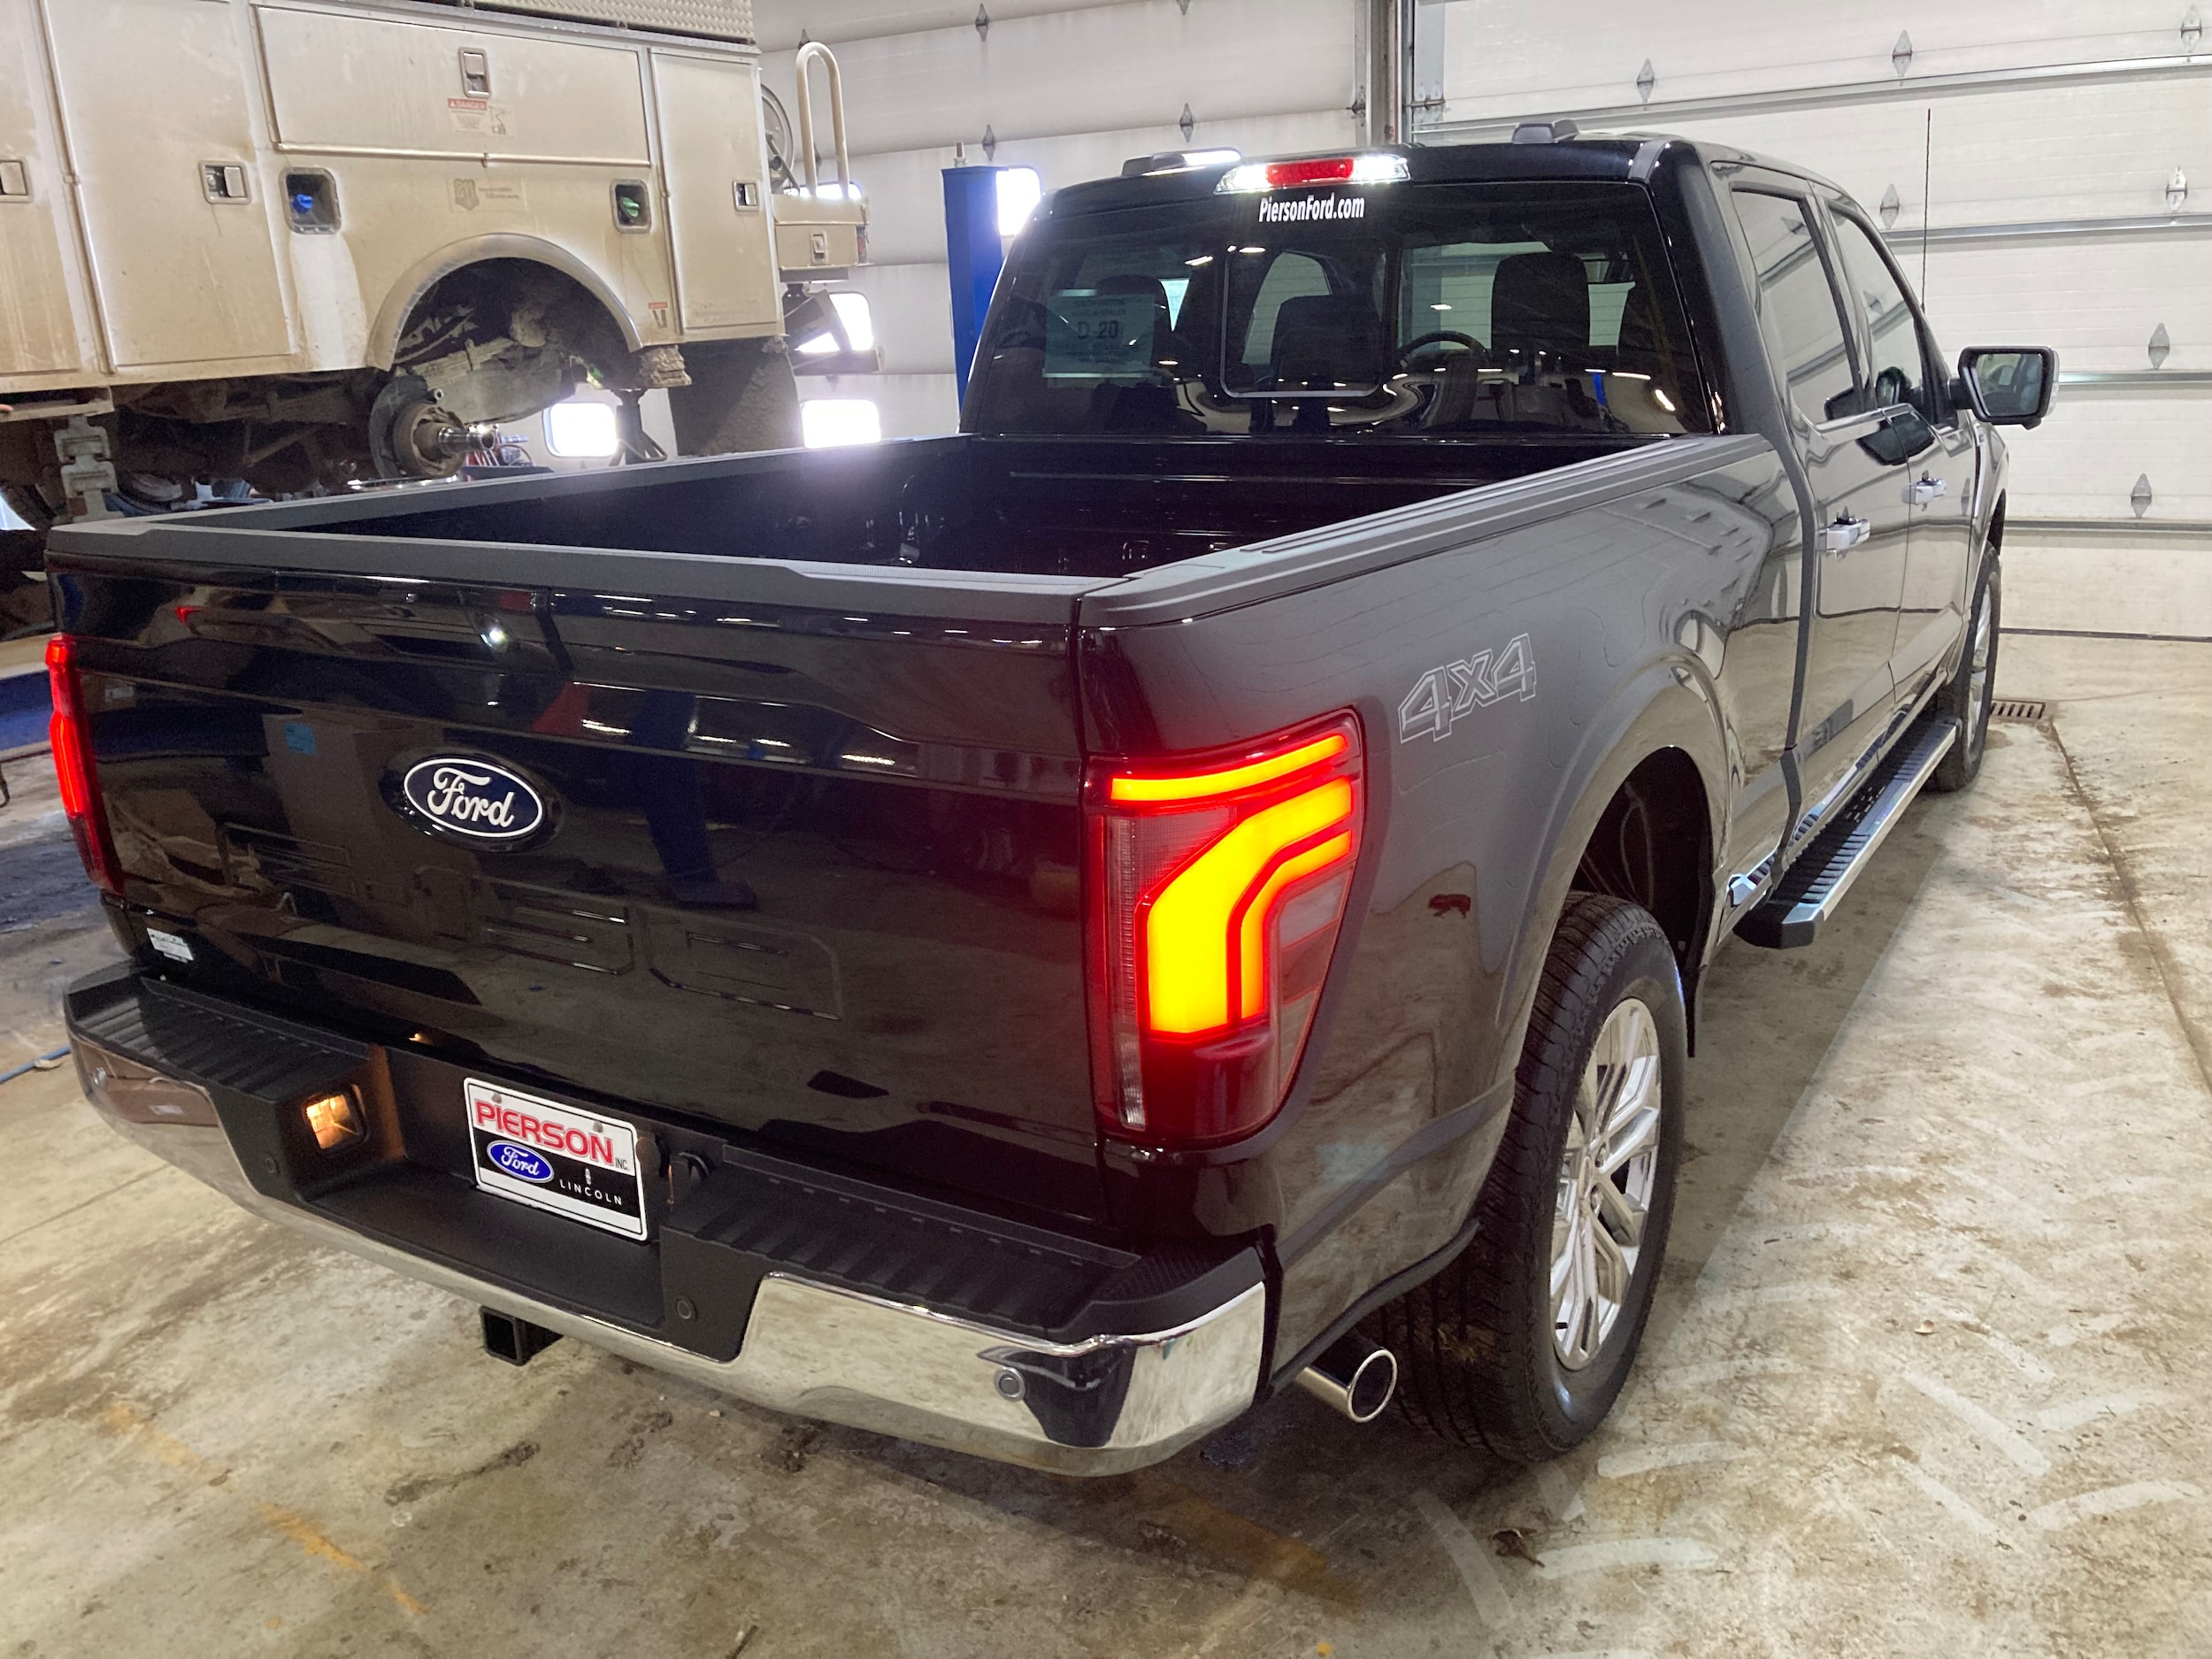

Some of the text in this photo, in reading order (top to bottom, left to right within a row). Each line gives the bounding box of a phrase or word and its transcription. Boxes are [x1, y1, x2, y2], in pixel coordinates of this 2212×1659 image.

[1258, 192, 1365, 223] PiersonFord.com
[426, 766, 516, 828] Ford
[474, 1097, 614, 1165] PIERSON
[500, 1146, 541, 1177] Ford
[558, 1179, 623, 1206] LINCOLN
